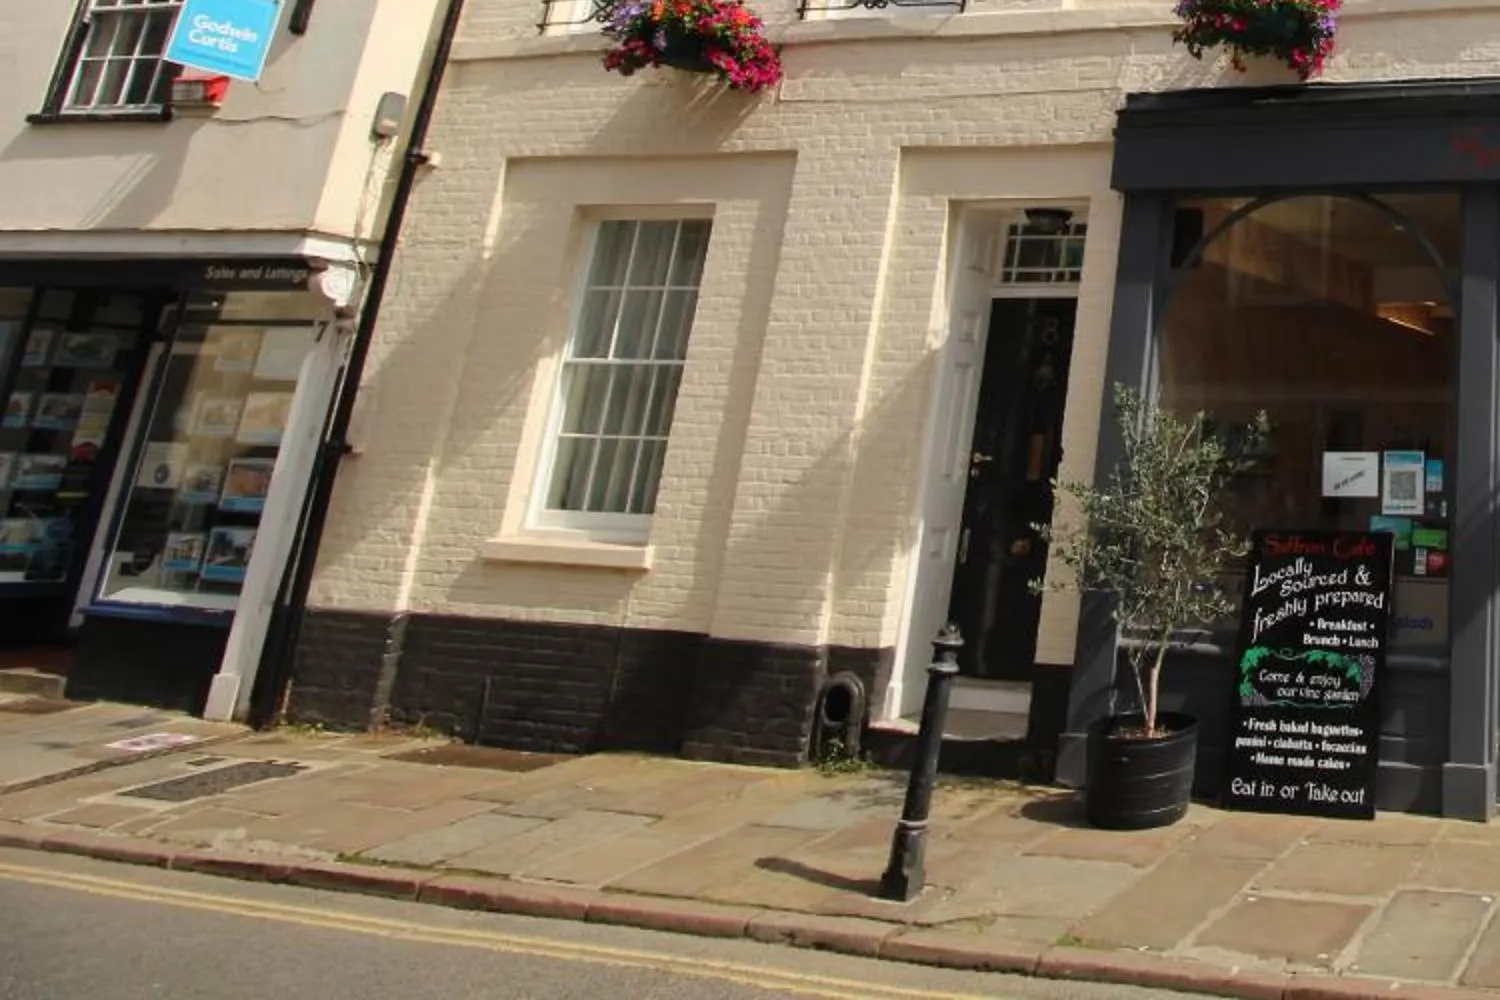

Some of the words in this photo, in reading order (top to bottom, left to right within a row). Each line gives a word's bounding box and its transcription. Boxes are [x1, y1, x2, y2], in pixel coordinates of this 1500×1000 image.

[193, 14, 257, 43] Godwin
[188, 28, 238, 53] Curtis
[315, 320, 330, 342] 7
[1251, 557, 1313, 597] Locally
[1355, 564, 1373, 586] &
[1251, 597, 1307, 644] freshly
[1314, 591, 1385, 612] prepared
[1317, 617, 1368, 632] Breakfast
[1303, 633, 1341, 646] Brunch
[1349, 636, 1379, 649] Lunch
[1259, 669, 1290, 683] Come
[1309, 674, 1342, 689] enjoy
[1248, 717, 1277, 732] Fresh
[1279, 720, 1309, 734] baked
[1255, 752, 1285, 766] Home
[1287, 754, 1315, 767] made
[1318, 756, 1345, 770] cakes
[1260, 780, 1275, 797] in
[1280, 785, 1299, 800] or
[1304, 781, 1339, 802] Take
[1341, 787, 1365, 804] out
